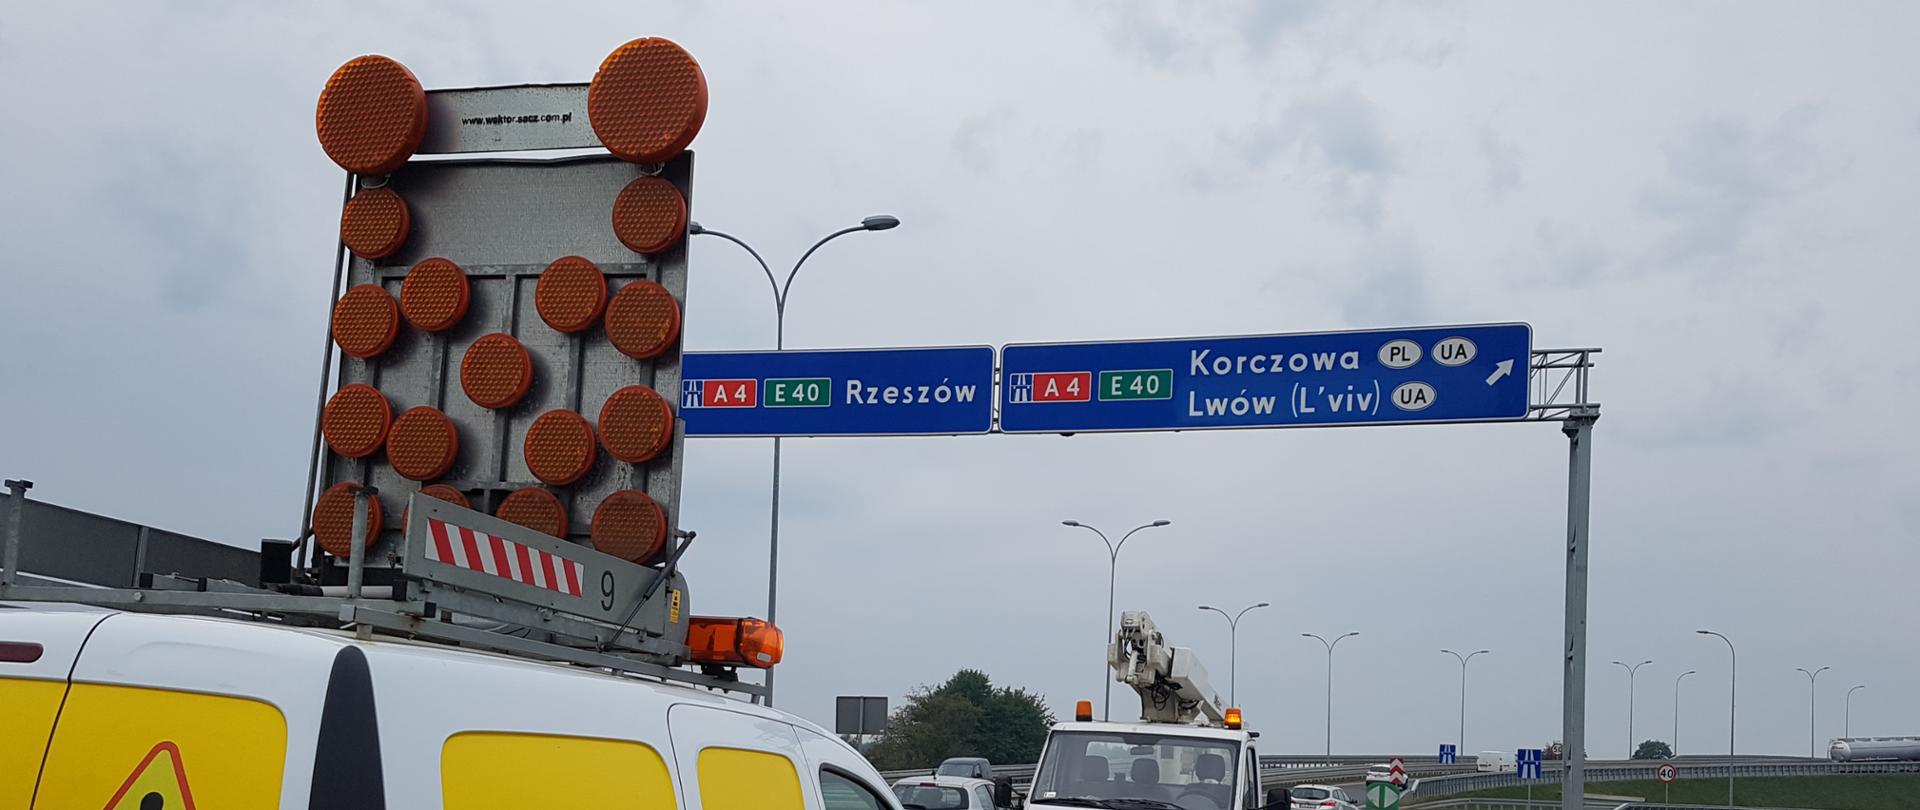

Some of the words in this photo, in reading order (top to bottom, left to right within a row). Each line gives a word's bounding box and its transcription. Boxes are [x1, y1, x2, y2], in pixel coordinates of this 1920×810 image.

[1190, 350, 1359, 376] Korczowa
[1390, 346, 1411, 361] PL
[1441, 344, 1467, 360] UA
[713, 385, 727, 402] A
[734, 384, 747, 402] 4
[775, 384, 785, 401] E
[791, 383, 819, 401] 40
[846, 377, 976, 404] Rzeszów
[1044, 378, 1059, 397] A
[1066, 377, 1080, 396] 4
[1111, 376, 1122, 395] E
[1130, 375, 1160, 394] 40
[1188, 389, 1276, 416] Lwów
[1400, 388, 1427, 404] UA
[601, 570, 615, 611] 9
[1661, 769, 1674, 778] 40
